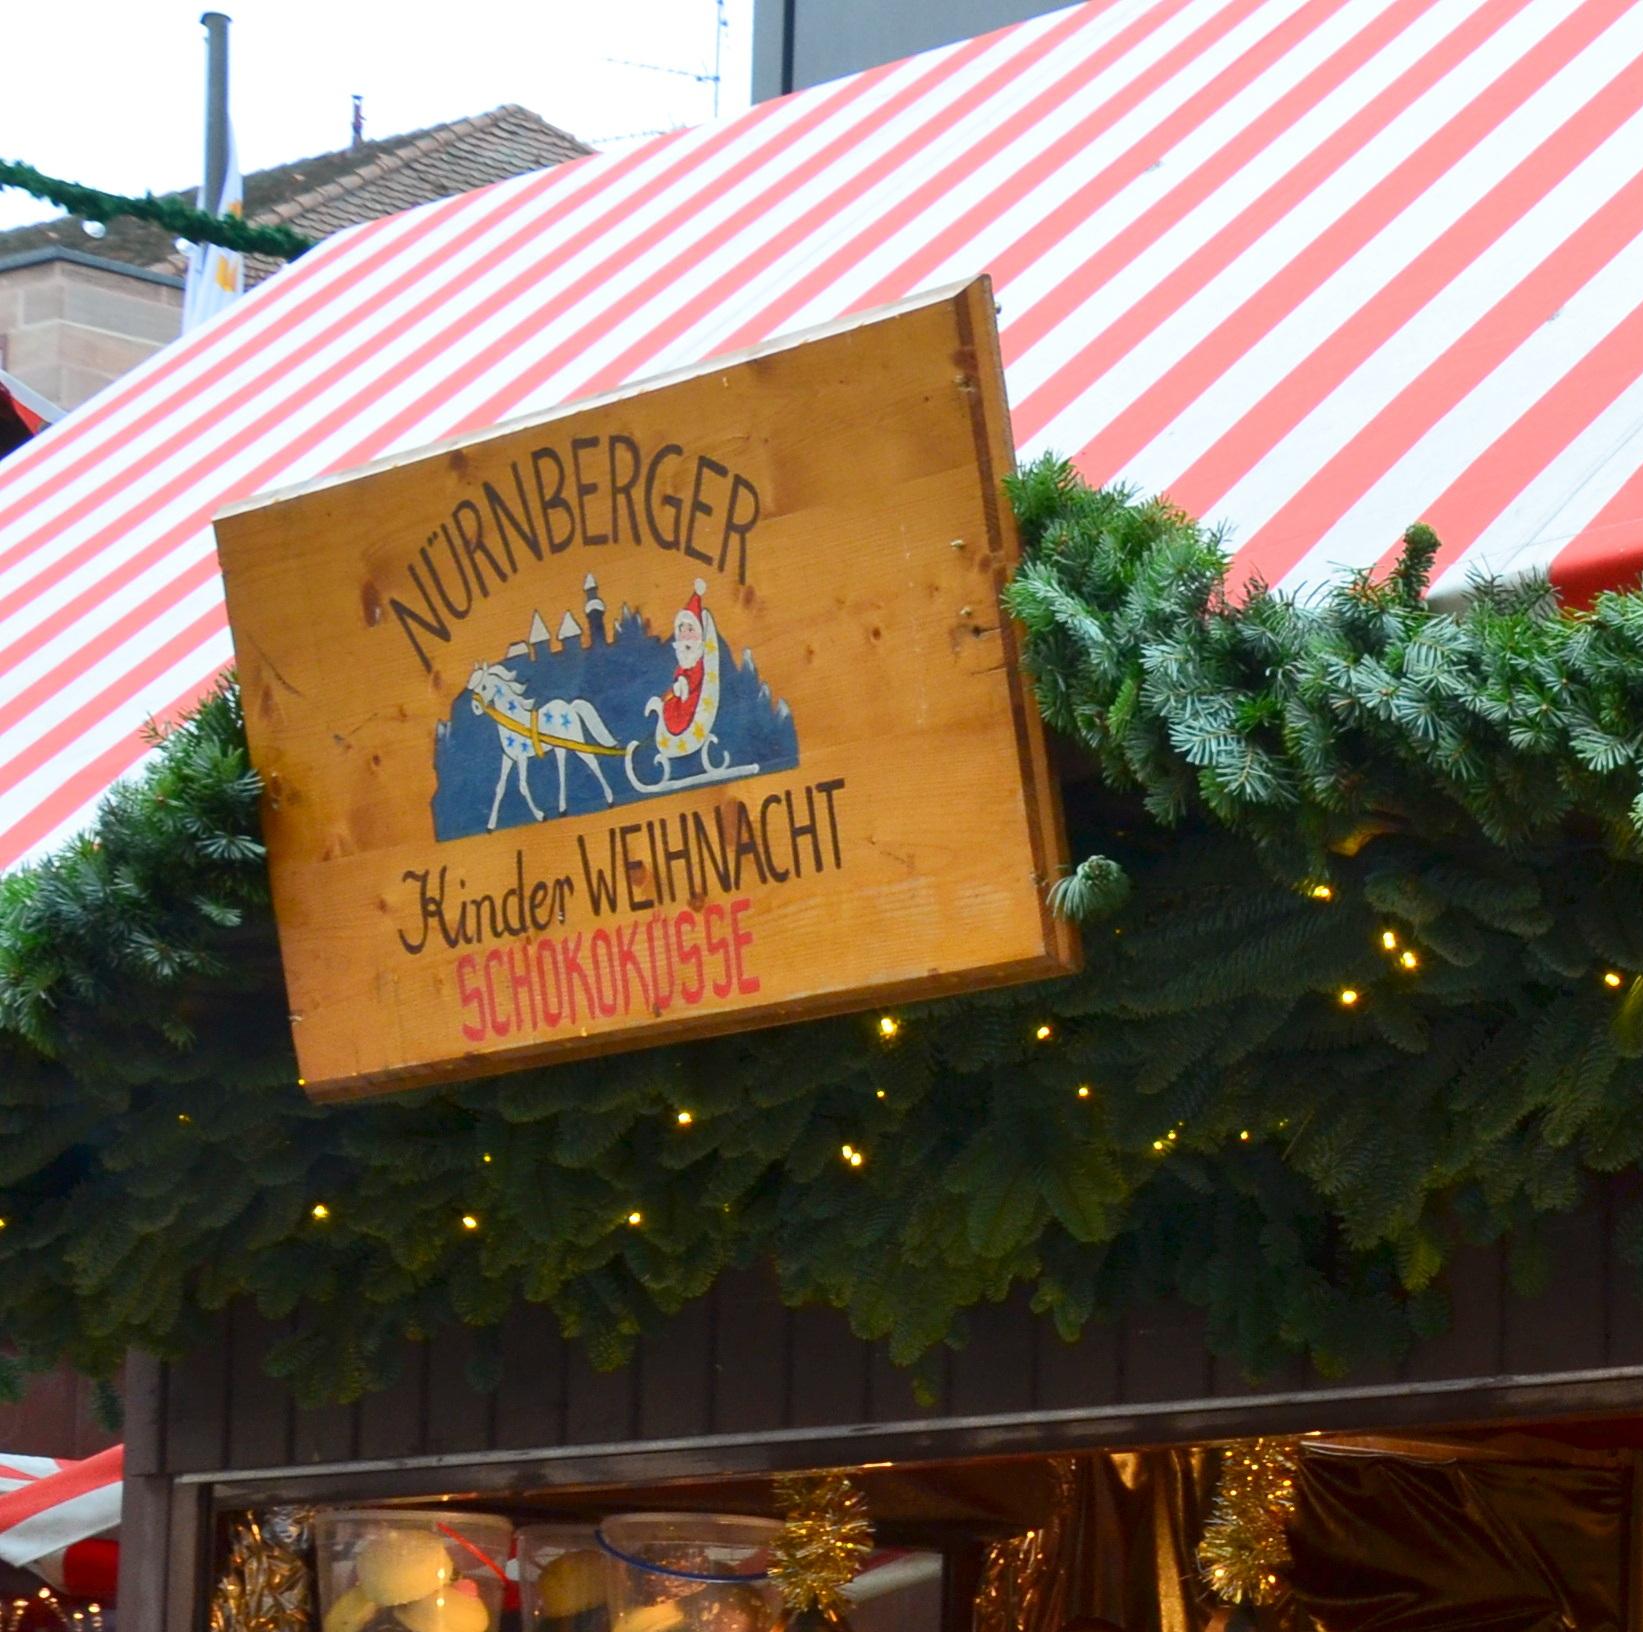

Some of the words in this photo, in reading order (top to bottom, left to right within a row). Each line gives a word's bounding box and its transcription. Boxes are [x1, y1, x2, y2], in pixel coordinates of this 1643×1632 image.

[388, 434, 760, 673] NÜRNBERGER
[398, 849, 574, 955] Kinder
[578, 779, 846, 914] WEIHNACHT
[456, 898, 761, 1043] SCHOKOKÜSSE
